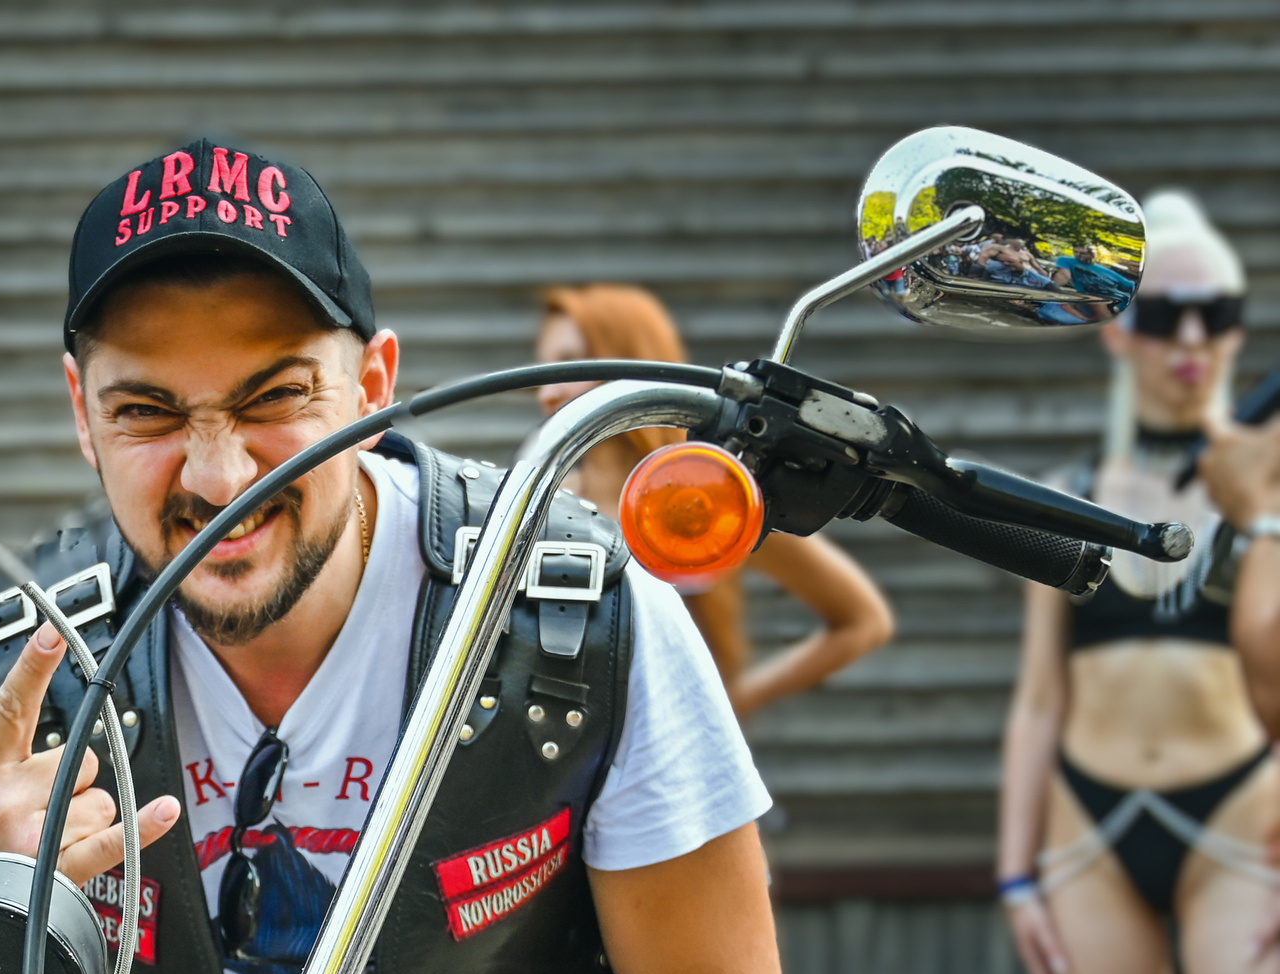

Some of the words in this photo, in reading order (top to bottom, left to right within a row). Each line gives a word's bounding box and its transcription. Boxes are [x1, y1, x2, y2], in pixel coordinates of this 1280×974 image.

[120, 147, 291, 216] LRMC
[115, 195, 292, 246] SUPPORT
[467, 828, 552, 886] RUSSIA
